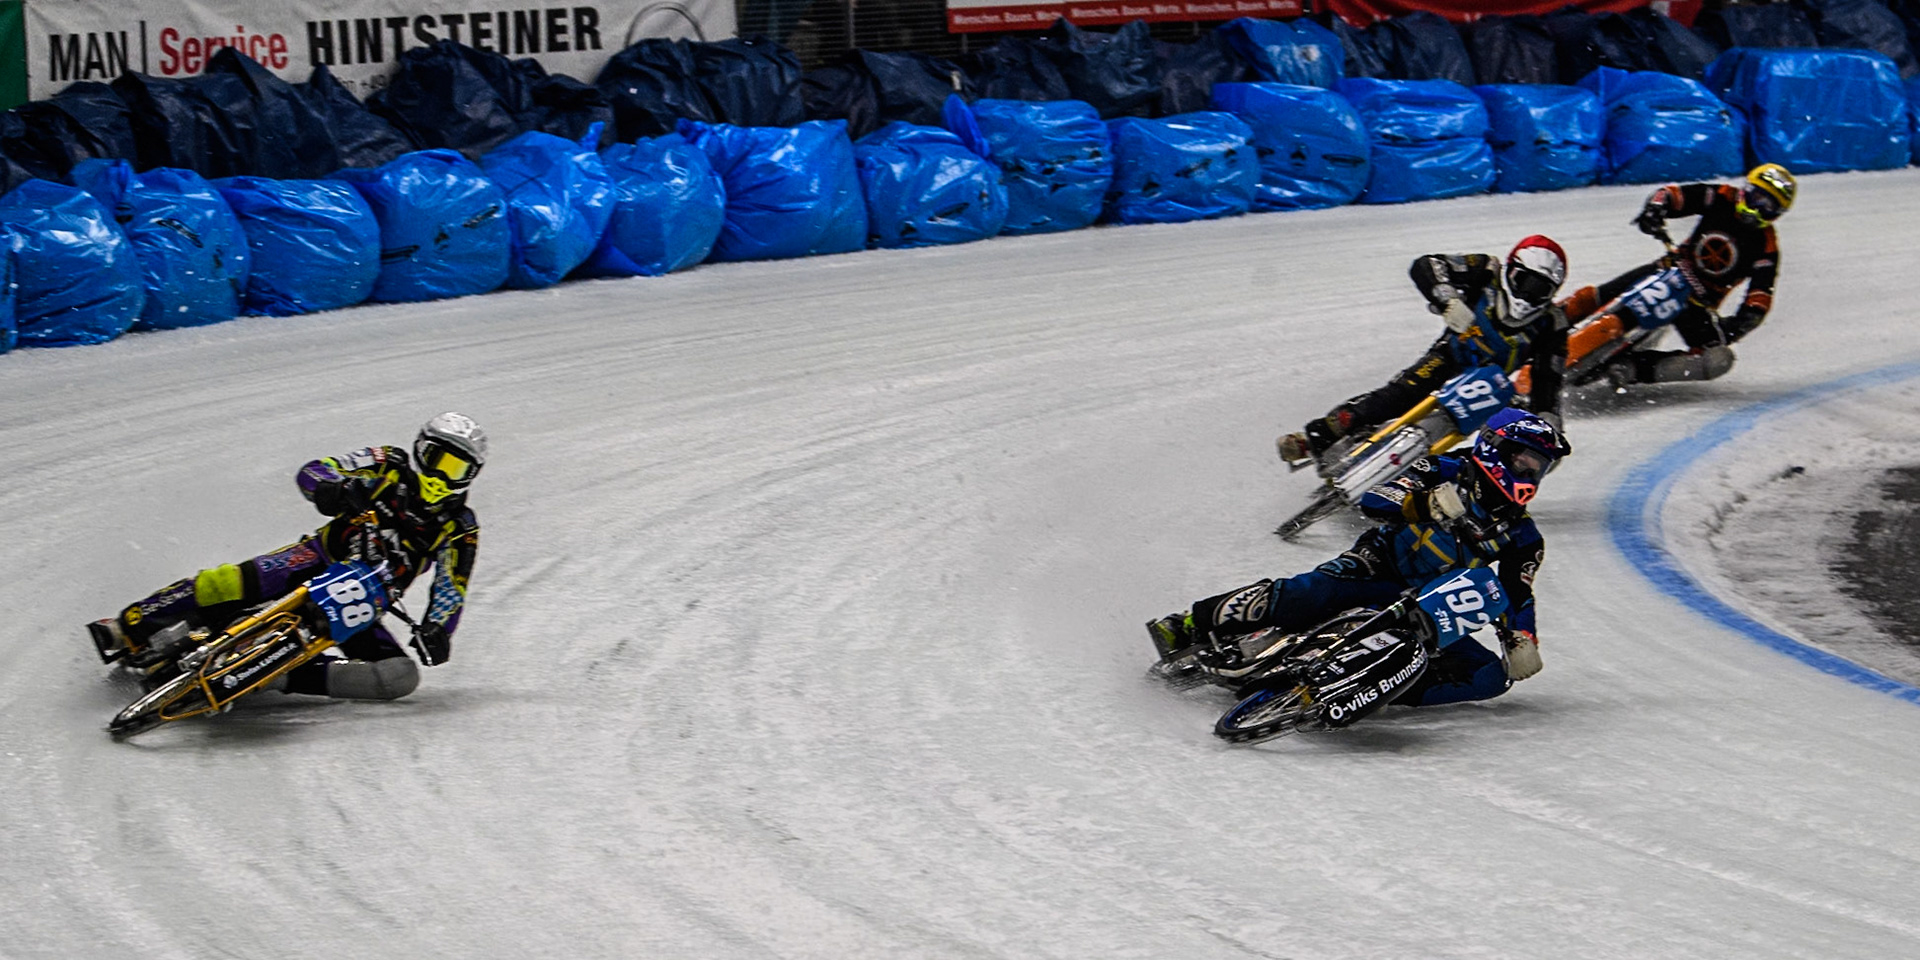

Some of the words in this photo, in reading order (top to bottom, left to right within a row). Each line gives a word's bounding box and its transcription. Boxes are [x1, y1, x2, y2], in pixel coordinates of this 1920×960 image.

[50, 30, 129, 81] MAN
[306, 6, 603, 67] HINTSTEINER
[1640, 281, 1681, 320] 25
[1445, 398, 1470, 419] FIM
[1456, 380, 1501, 411] 81
[324, 606, 339, 622] FIM
[326, 578, 375, 628] 88
[1434, 607, 1453, 633] FIM
[1438, 575, 1491, 635] 192
[1329, 687, 1379, 721] Ö-viks
